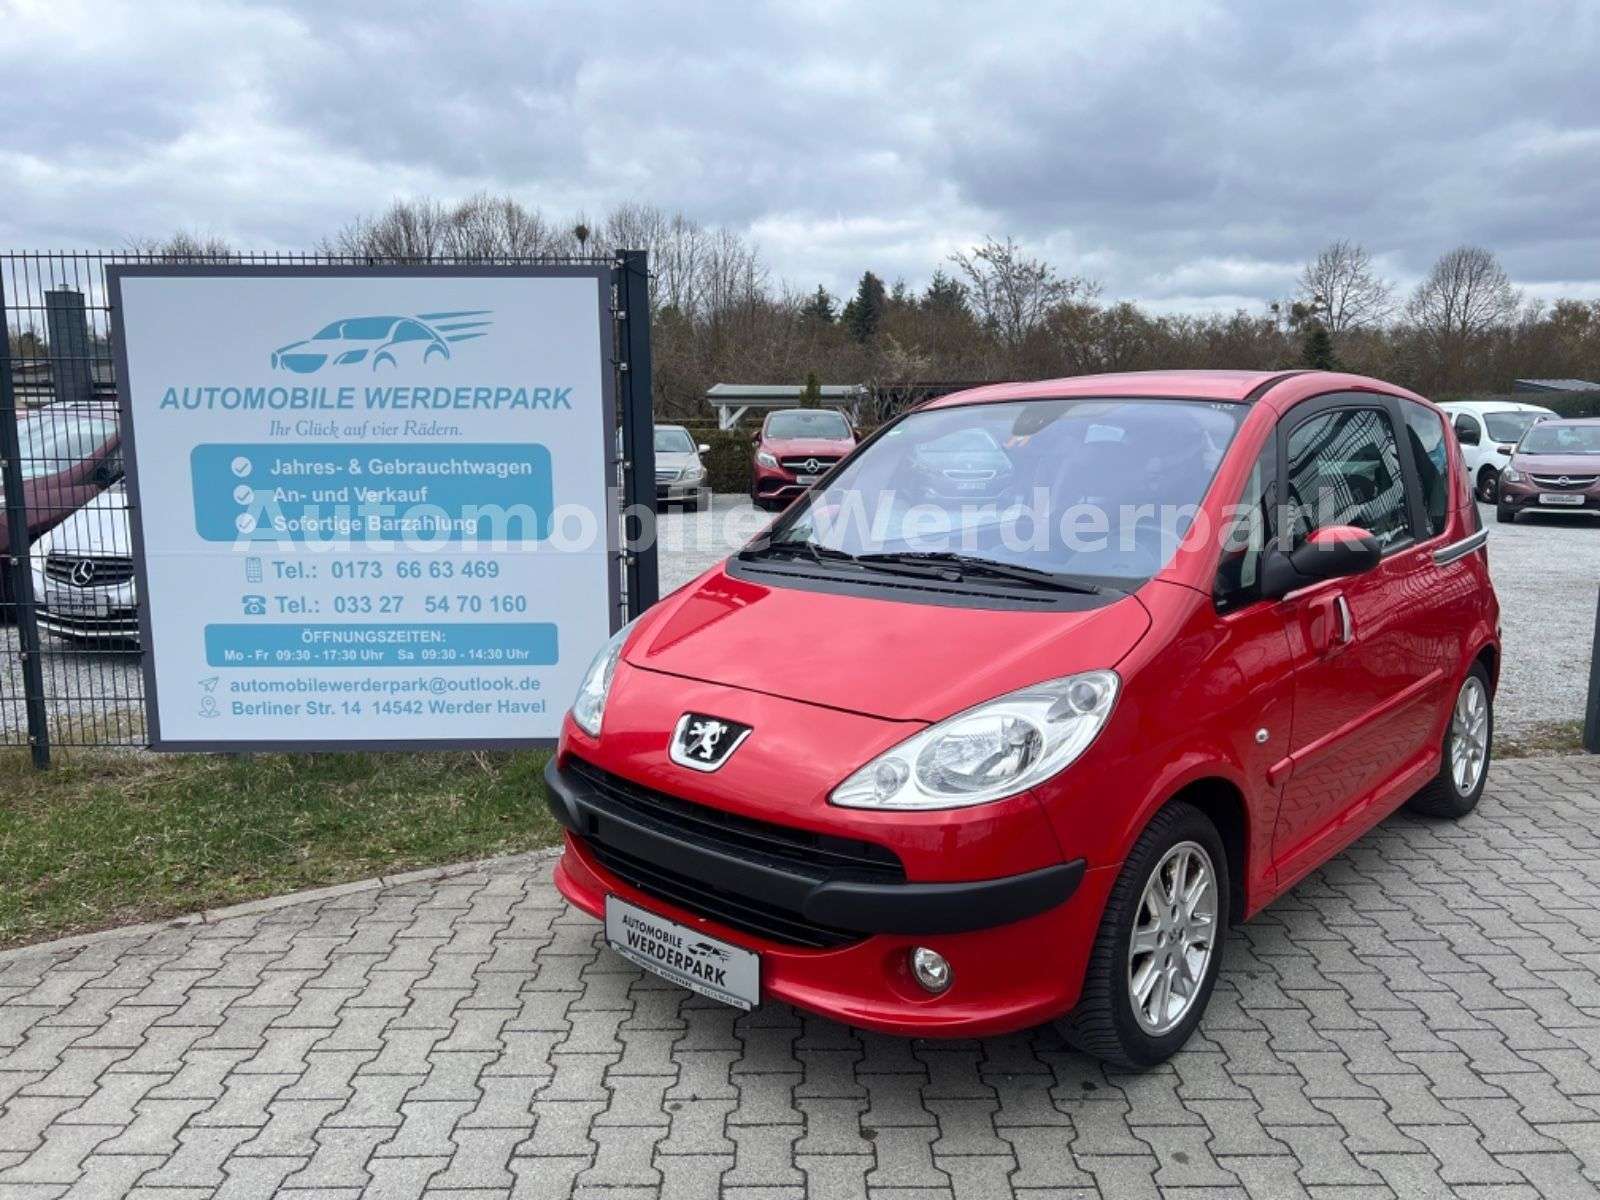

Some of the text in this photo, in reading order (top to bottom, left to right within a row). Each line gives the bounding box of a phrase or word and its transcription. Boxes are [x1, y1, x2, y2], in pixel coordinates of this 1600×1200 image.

[160, 386, 573, 410] AUTOMOBILE WERDERPARK
[269, 419, 463, 439] Ihr Glück auf vier Rädern.
[271, 458, 532, 478] Jahres- & Gebrauchtwagen
[273, 486, 428, 503] An- und Verkauf
[273, 514, 477, 535] Sofortige Barzahlung
[272, 560, 499, 579] Tel.: 0173 66 63 469
[274, 595, 527, 613] Tel.: 033 27 54 70 160
[302, 628, 446, 643] ÖFFNUNGSZEITEN:
[224, 649, 244, 661] Mo
[255, 649, 269, 661] Fr
[276, 649, 310, 661] 09:30
[324, 649, 357, 661] 17:30
[360, 649, 385, 661] Uhr
[398, 649, 414, 661] Sa
[421, 648, 456, 660] 09:30
[468, 648, 502, 660] 14:30
[506, 648, 529, 660] Uhr
[230, 677, 541, 695] automobilewerderpark@outlook.de
[232, 699, 546, 715] Berliner Str. 14 14542 Werder Havel
[622, 914, 684, 949] AUTOMOBILE
[627, 929, 727, 987] WERDERPARK
